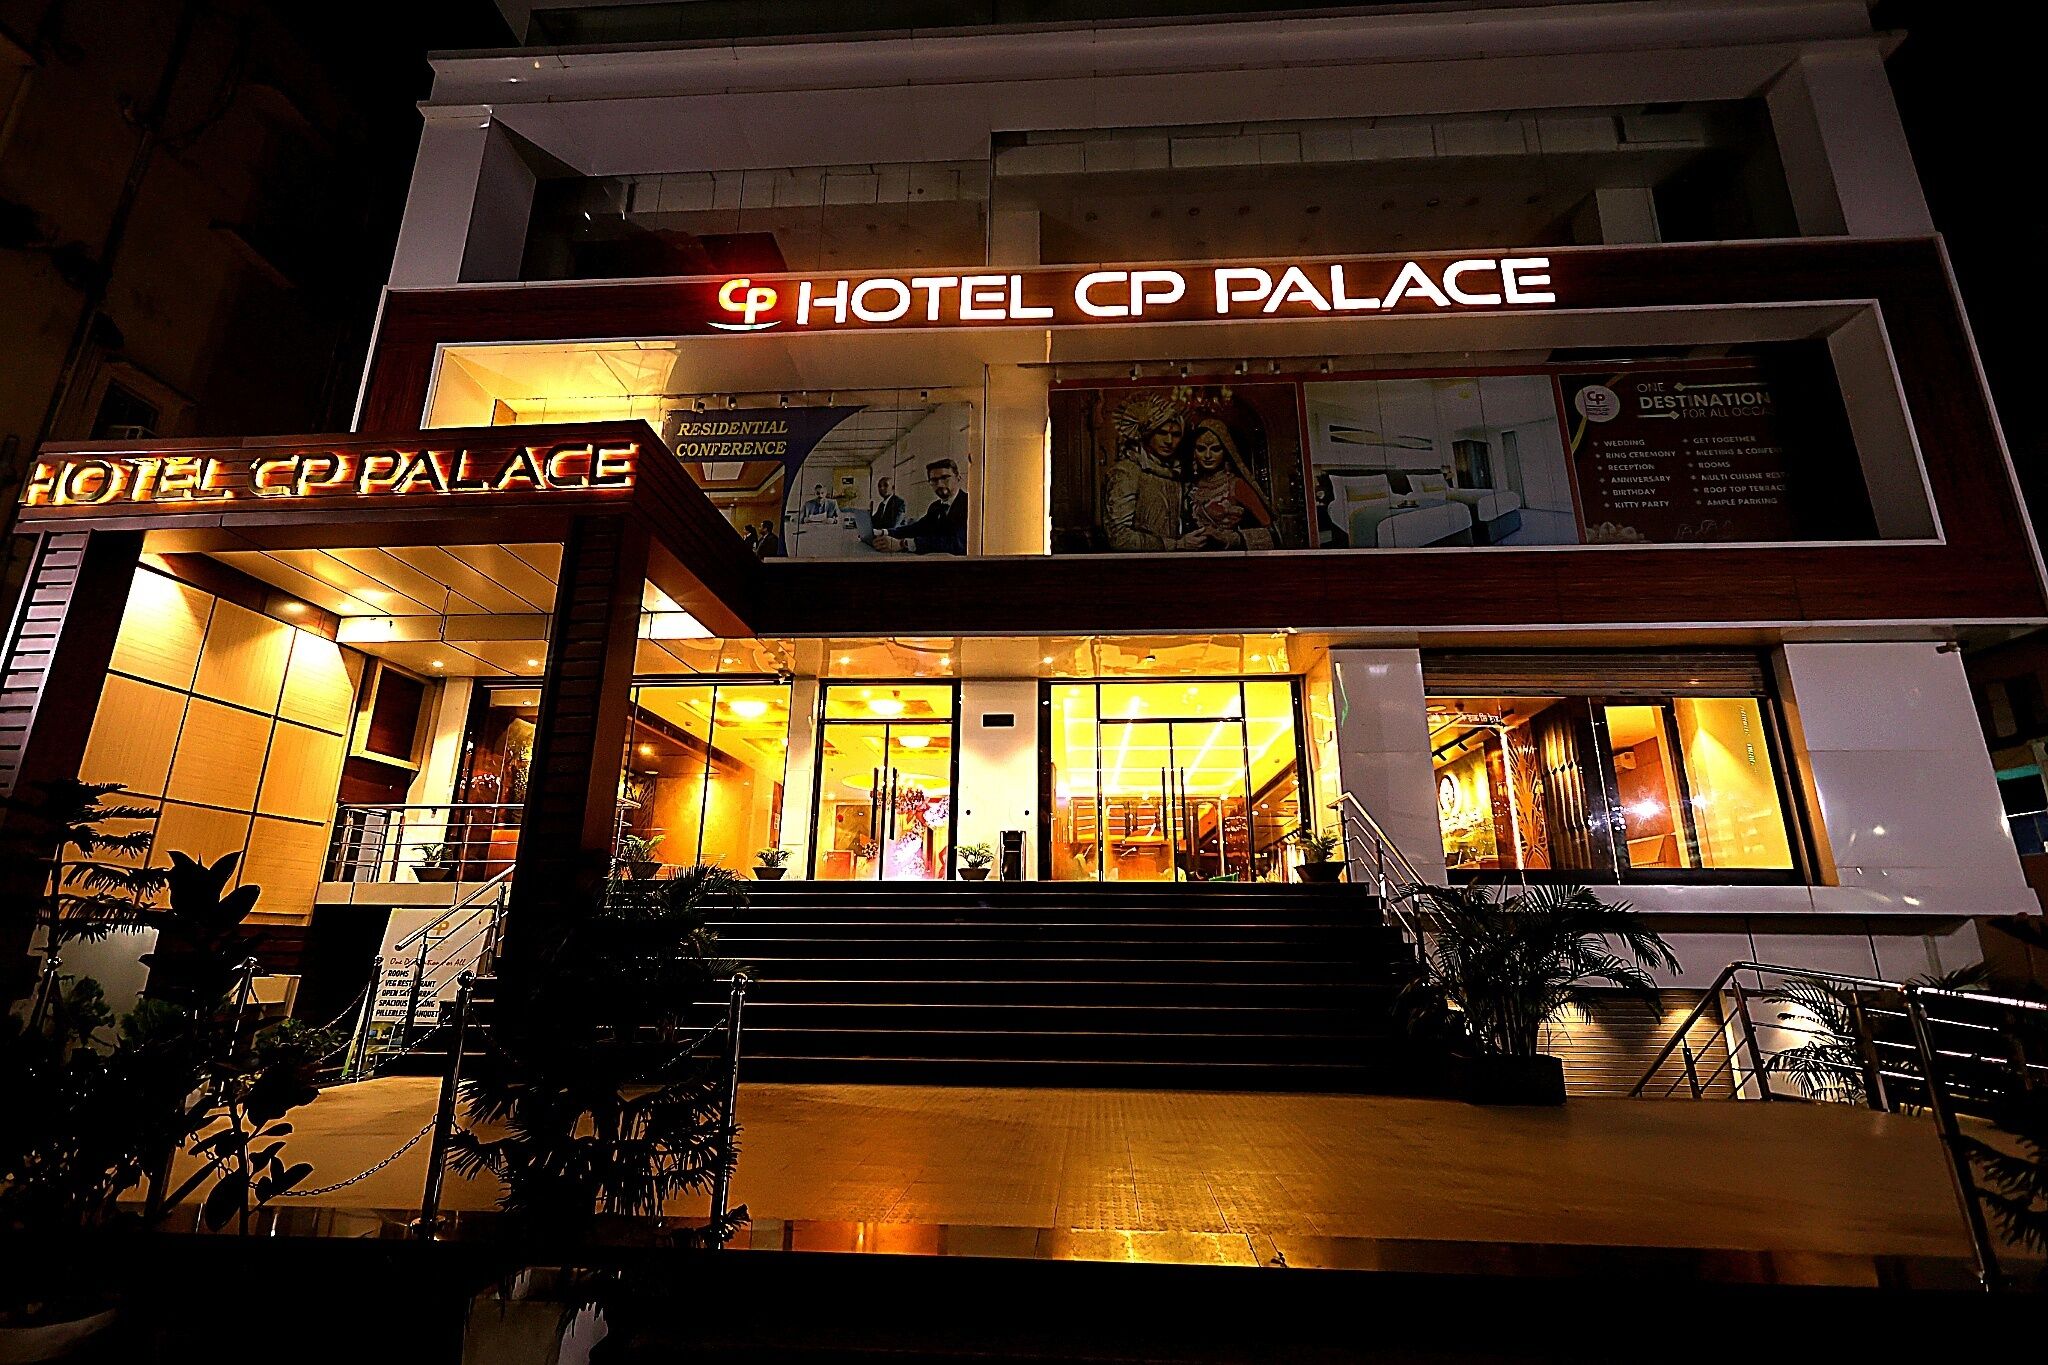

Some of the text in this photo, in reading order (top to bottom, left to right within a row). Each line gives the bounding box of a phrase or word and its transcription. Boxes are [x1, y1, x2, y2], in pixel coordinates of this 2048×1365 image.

[796, 257, 1556, 325] HOTEL CP PALACE
[1637, 382, 1665, 393] ONE
[1640, 392, 1771, 409] DESTINATION
[1682, 409, 1707, 419] FOR
[1710, 407, 1731, 418] ALL
[677, 421, 789, 437] RESIDENTIAL
[1603, 439, 1646, 447] WEDDING
[1711, 435, 1757, 443] TOGETHER
[675, 441, 787, 457] CONFERENCE
[1629, 450, 1677, 458] CEREMONY
[1608, 463, 1656, 471] RECEPTION
[19, 442, 639, 505] HOTEL CP PALACE
[1701, 473, 1728, 481] MULTI
[1729, 472, 1764, 480] CUISINE
[1611, 475, 1671, 484] ANNIVERSARY
[1612, 488, 1656, 496] BIRTHDAY
[1703, 486, 1727, 494] ROOF
[1729, 485, 1747, 493] TOP
[1614, 500, 1670, 509] KITTY PARTY
[1706, 497, 1778, 506] AMPLE PARKING
